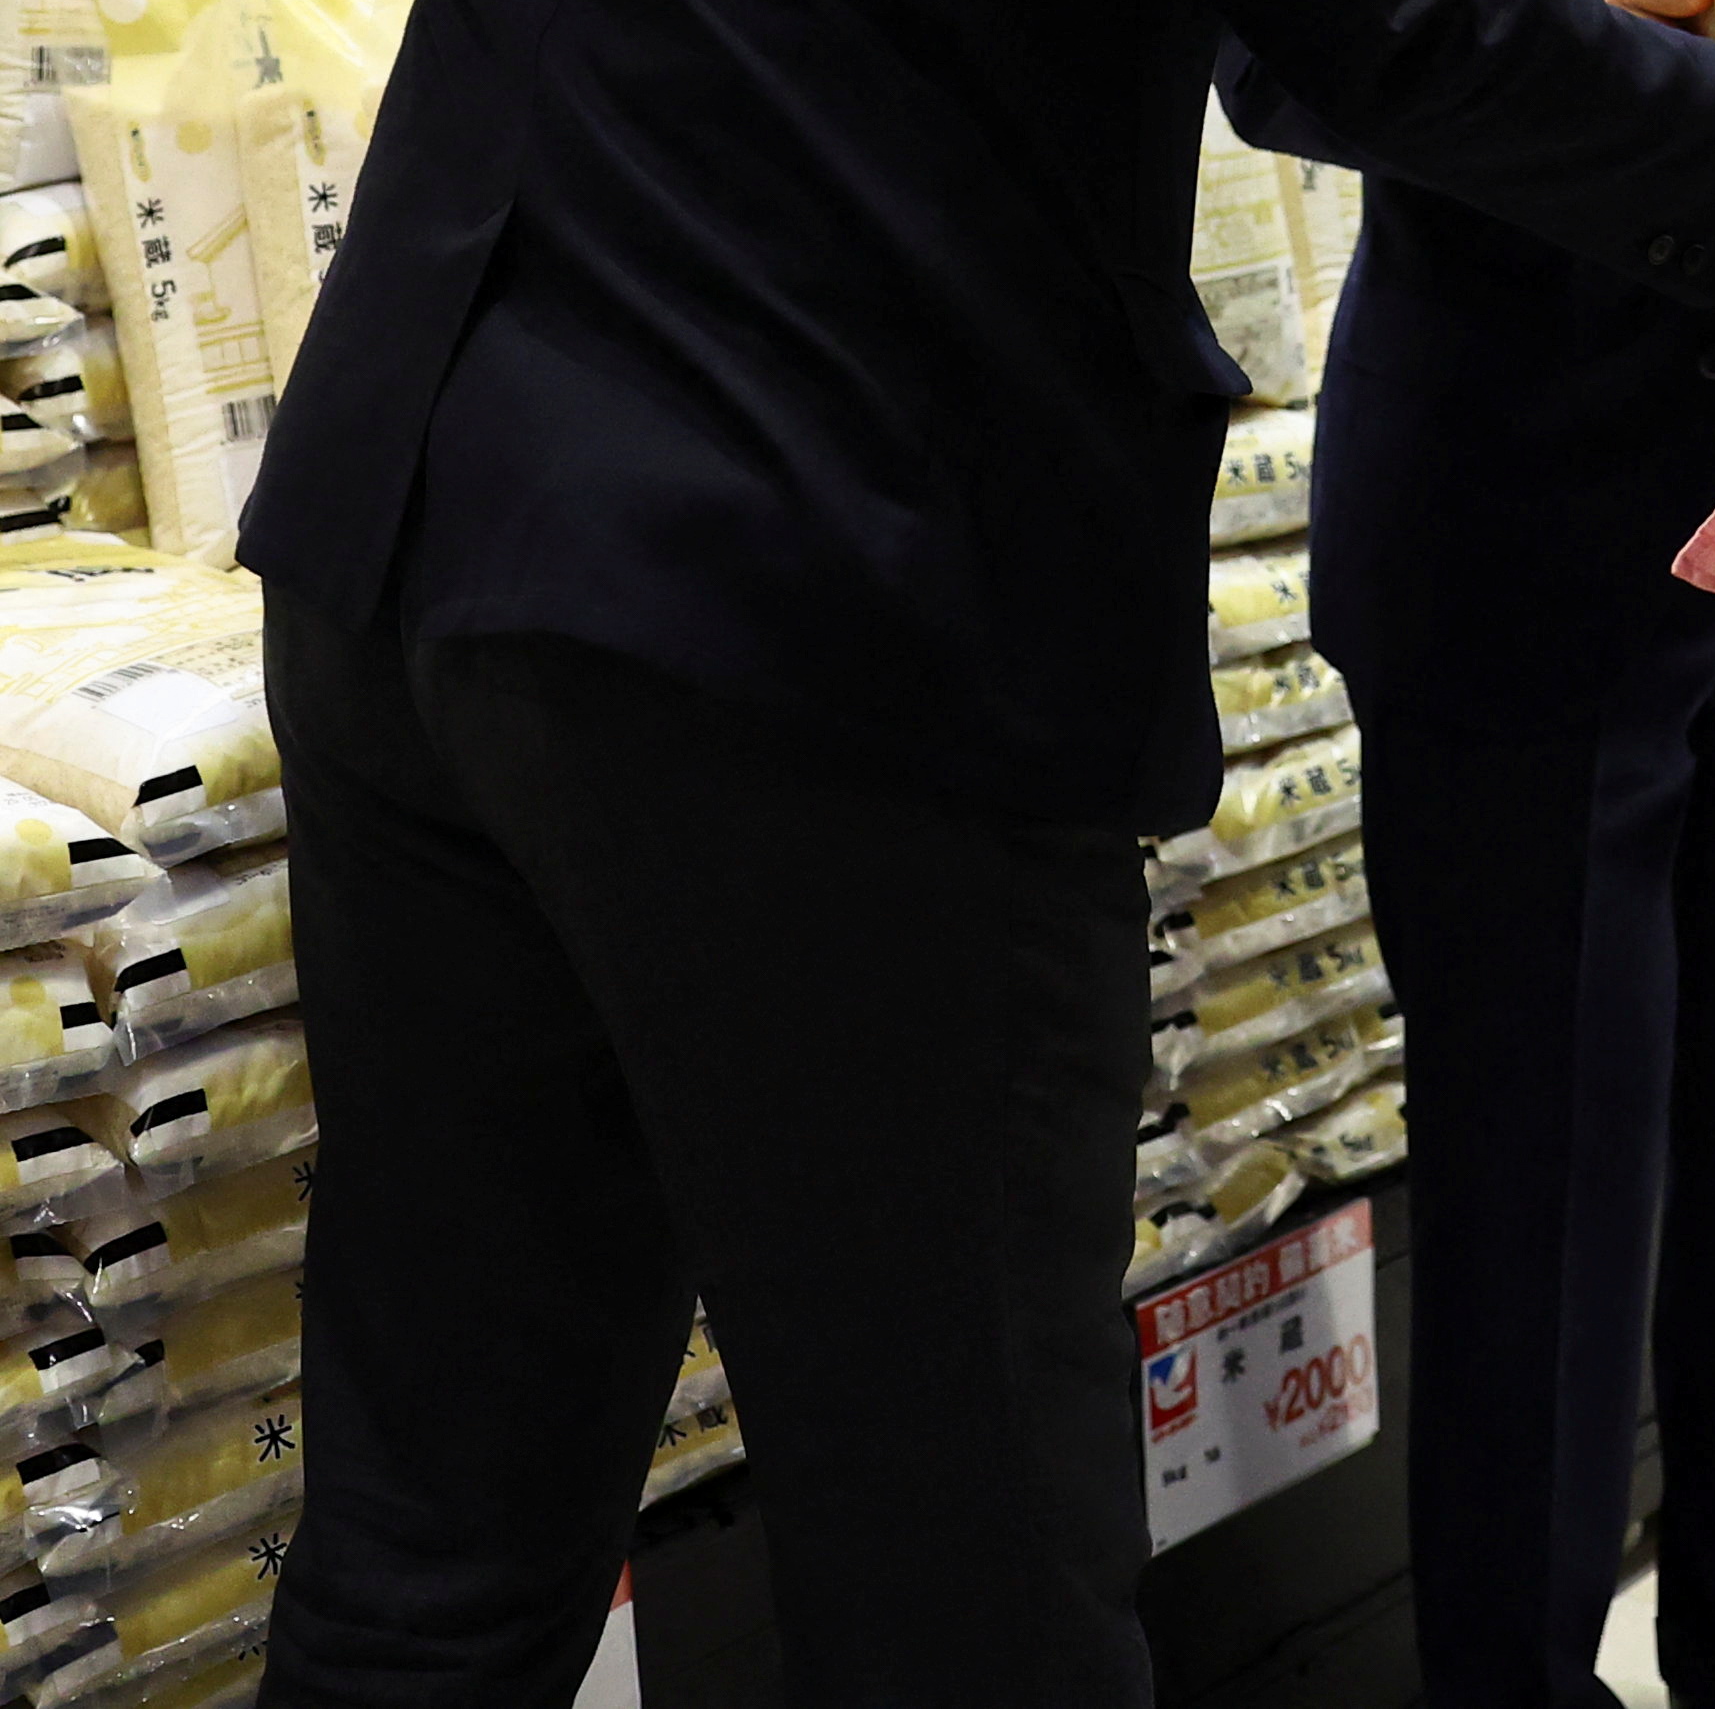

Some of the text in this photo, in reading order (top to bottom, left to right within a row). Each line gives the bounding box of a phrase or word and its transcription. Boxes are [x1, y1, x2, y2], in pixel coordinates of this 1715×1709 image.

[136, 197, 172, 269] 米蔵
[307, 181, 343, 254] 米蔵
[150, 278, 177, 322] 5kg
[1262, 1333, 1372, 1432] ¥2000
[254, 1414, 295, 1463] 米
